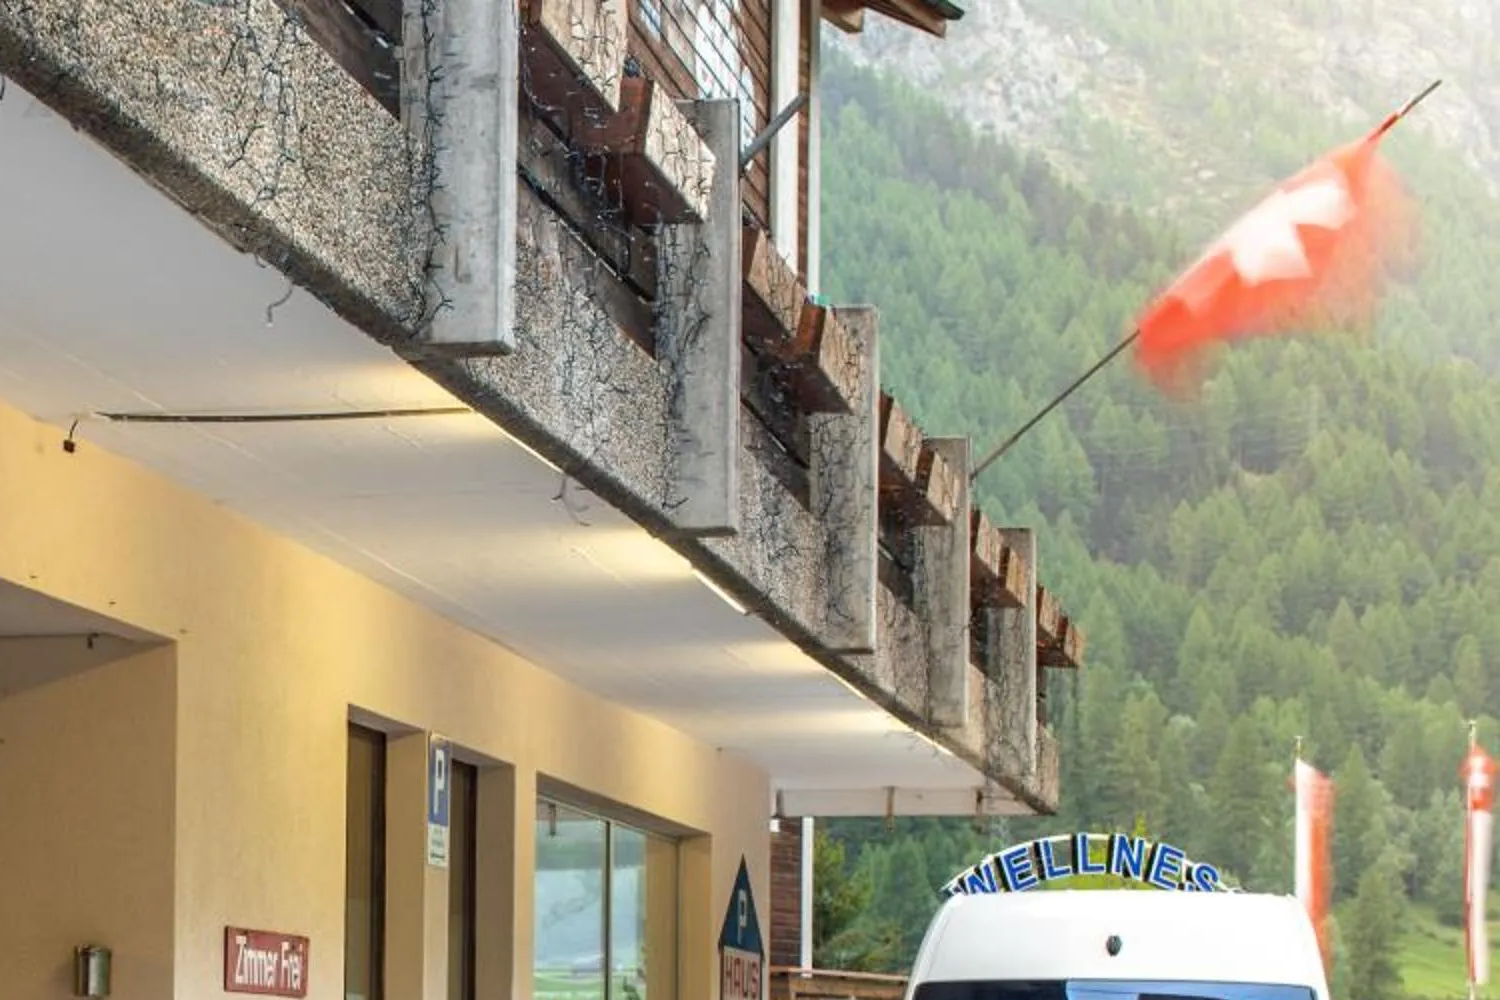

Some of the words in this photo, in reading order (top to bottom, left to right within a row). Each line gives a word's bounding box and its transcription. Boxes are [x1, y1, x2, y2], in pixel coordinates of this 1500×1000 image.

[433, 747, 446, 815] P
[736, 888, 748, 945] P
[235, 935, 278, 989] Zimmer
[723, 954, 758, 1000] HAUS
